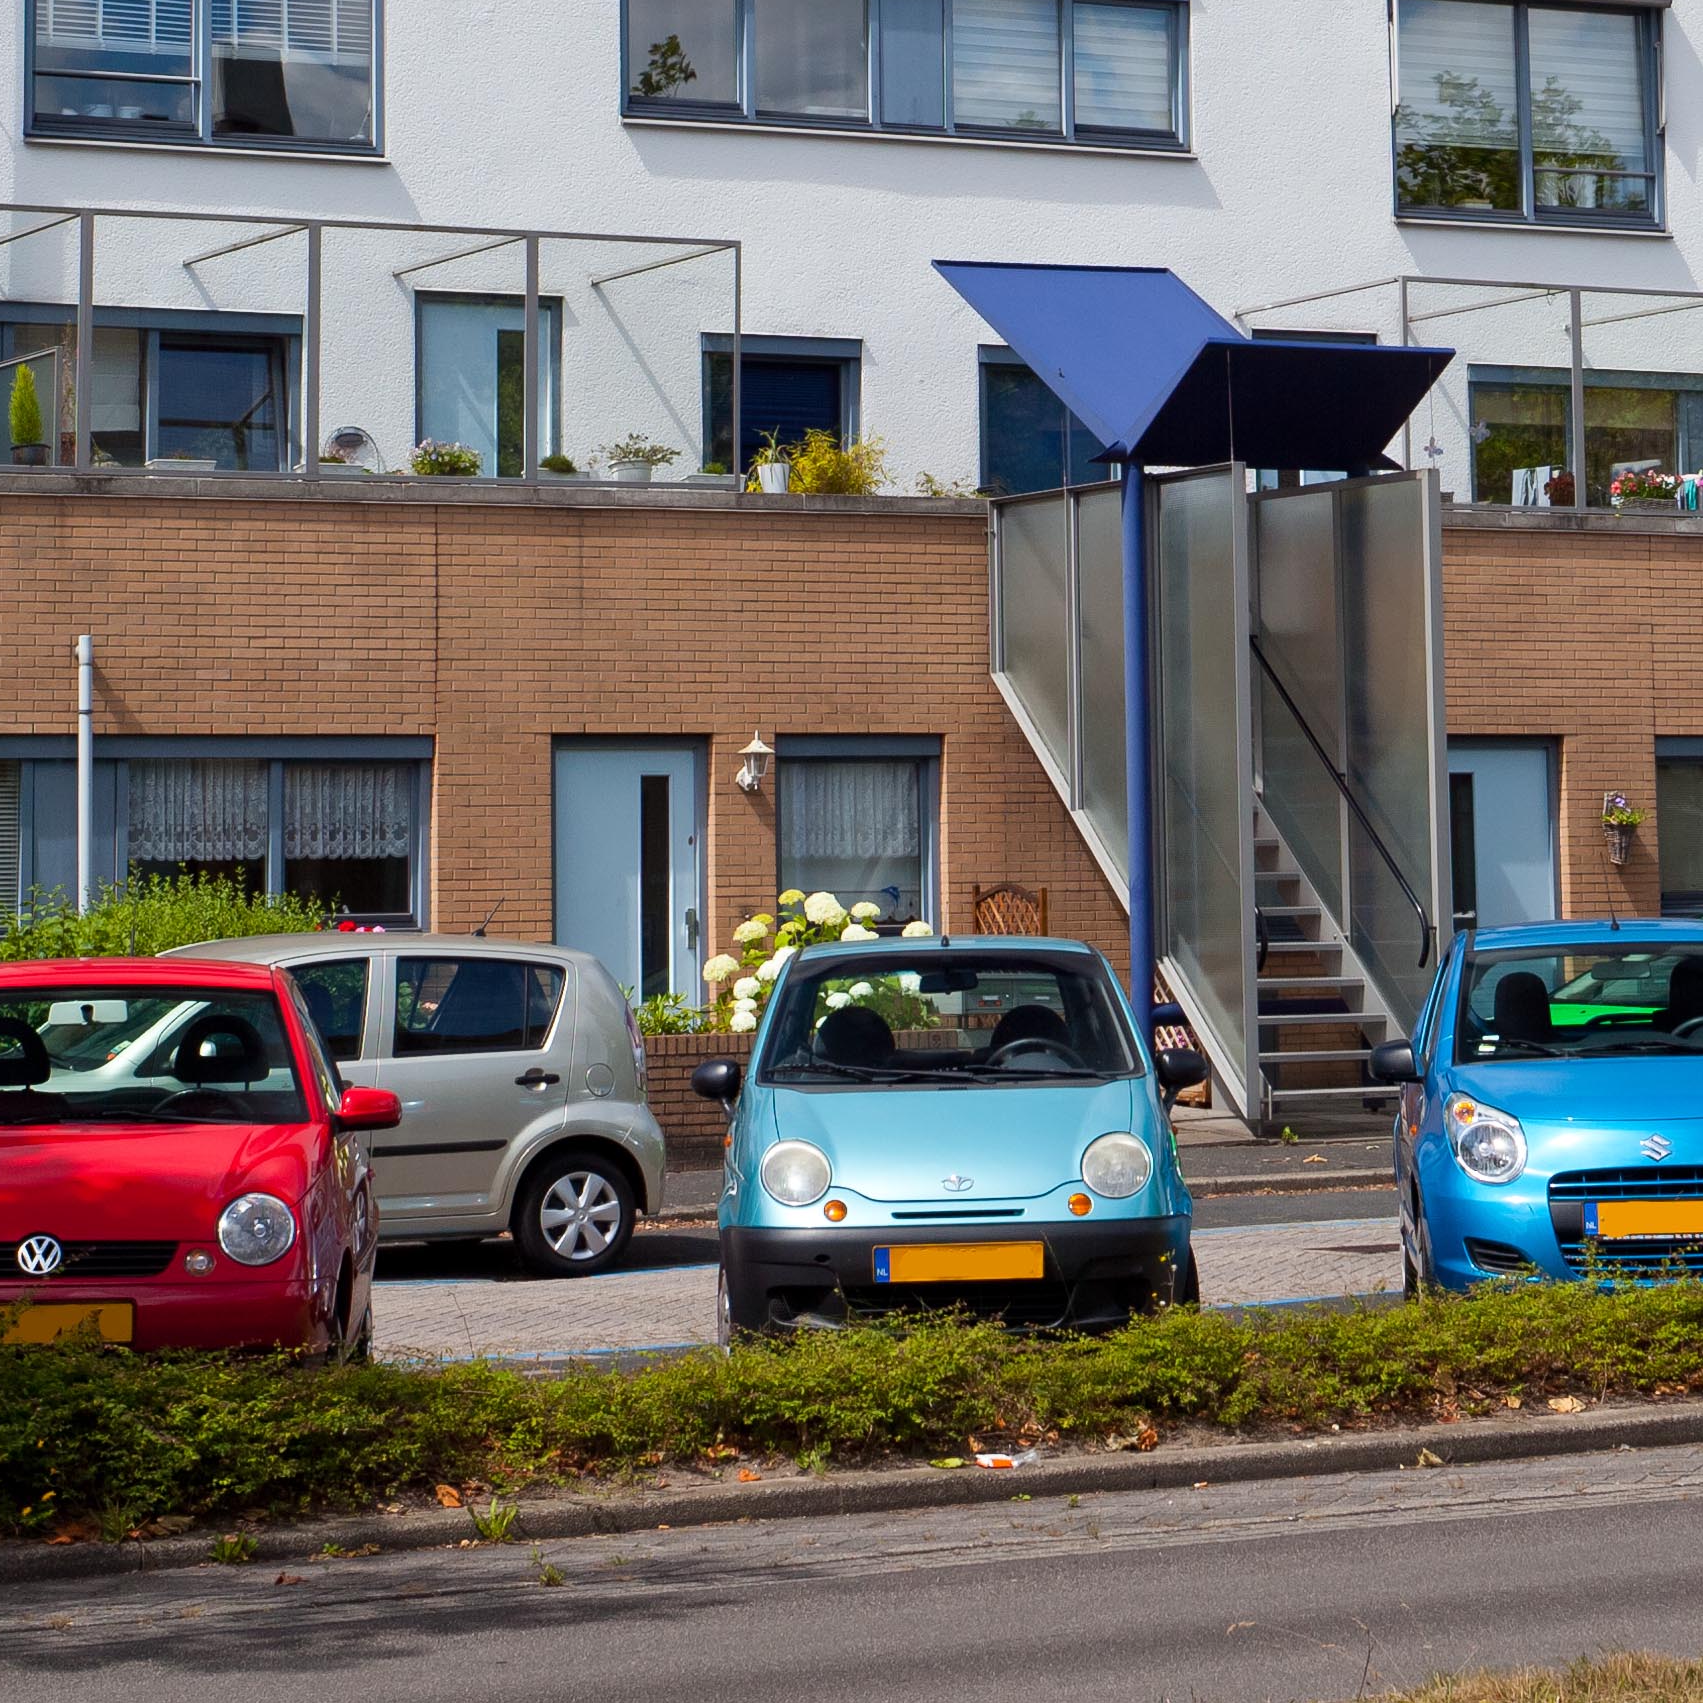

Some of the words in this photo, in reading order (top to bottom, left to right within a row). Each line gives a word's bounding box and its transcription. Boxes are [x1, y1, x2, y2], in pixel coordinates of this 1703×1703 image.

[1585, 1222, 1597, 1230] NL
[18, 1236, 61, 1274] VW
[876, 1268, 888, 1277] NL
